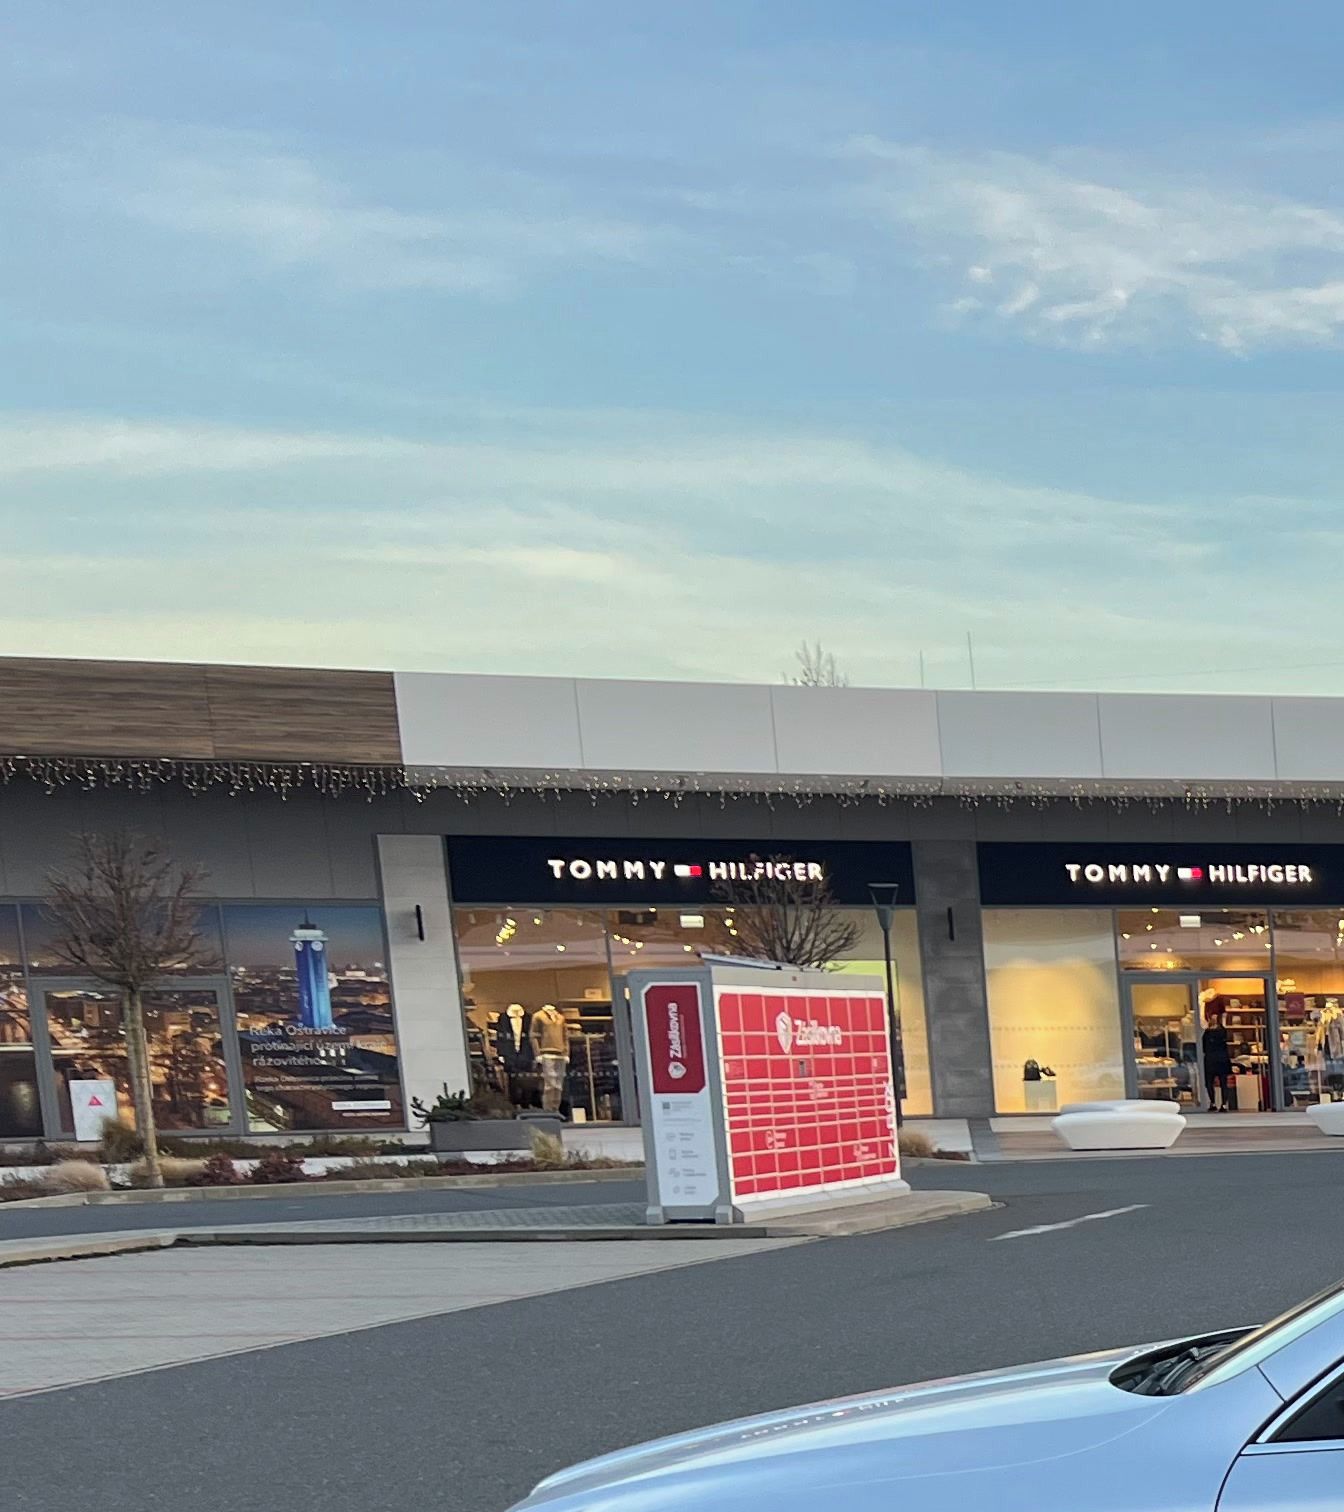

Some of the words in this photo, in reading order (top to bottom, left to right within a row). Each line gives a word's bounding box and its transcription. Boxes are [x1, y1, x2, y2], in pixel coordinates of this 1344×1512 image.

[548, 859, 666, 880] TOMMY
[708, 861, 824, 881] HILFIGER
[1065, 863, 1170, 882] TOMMY
[1208, 864, 1313, 883] HILFIGER
